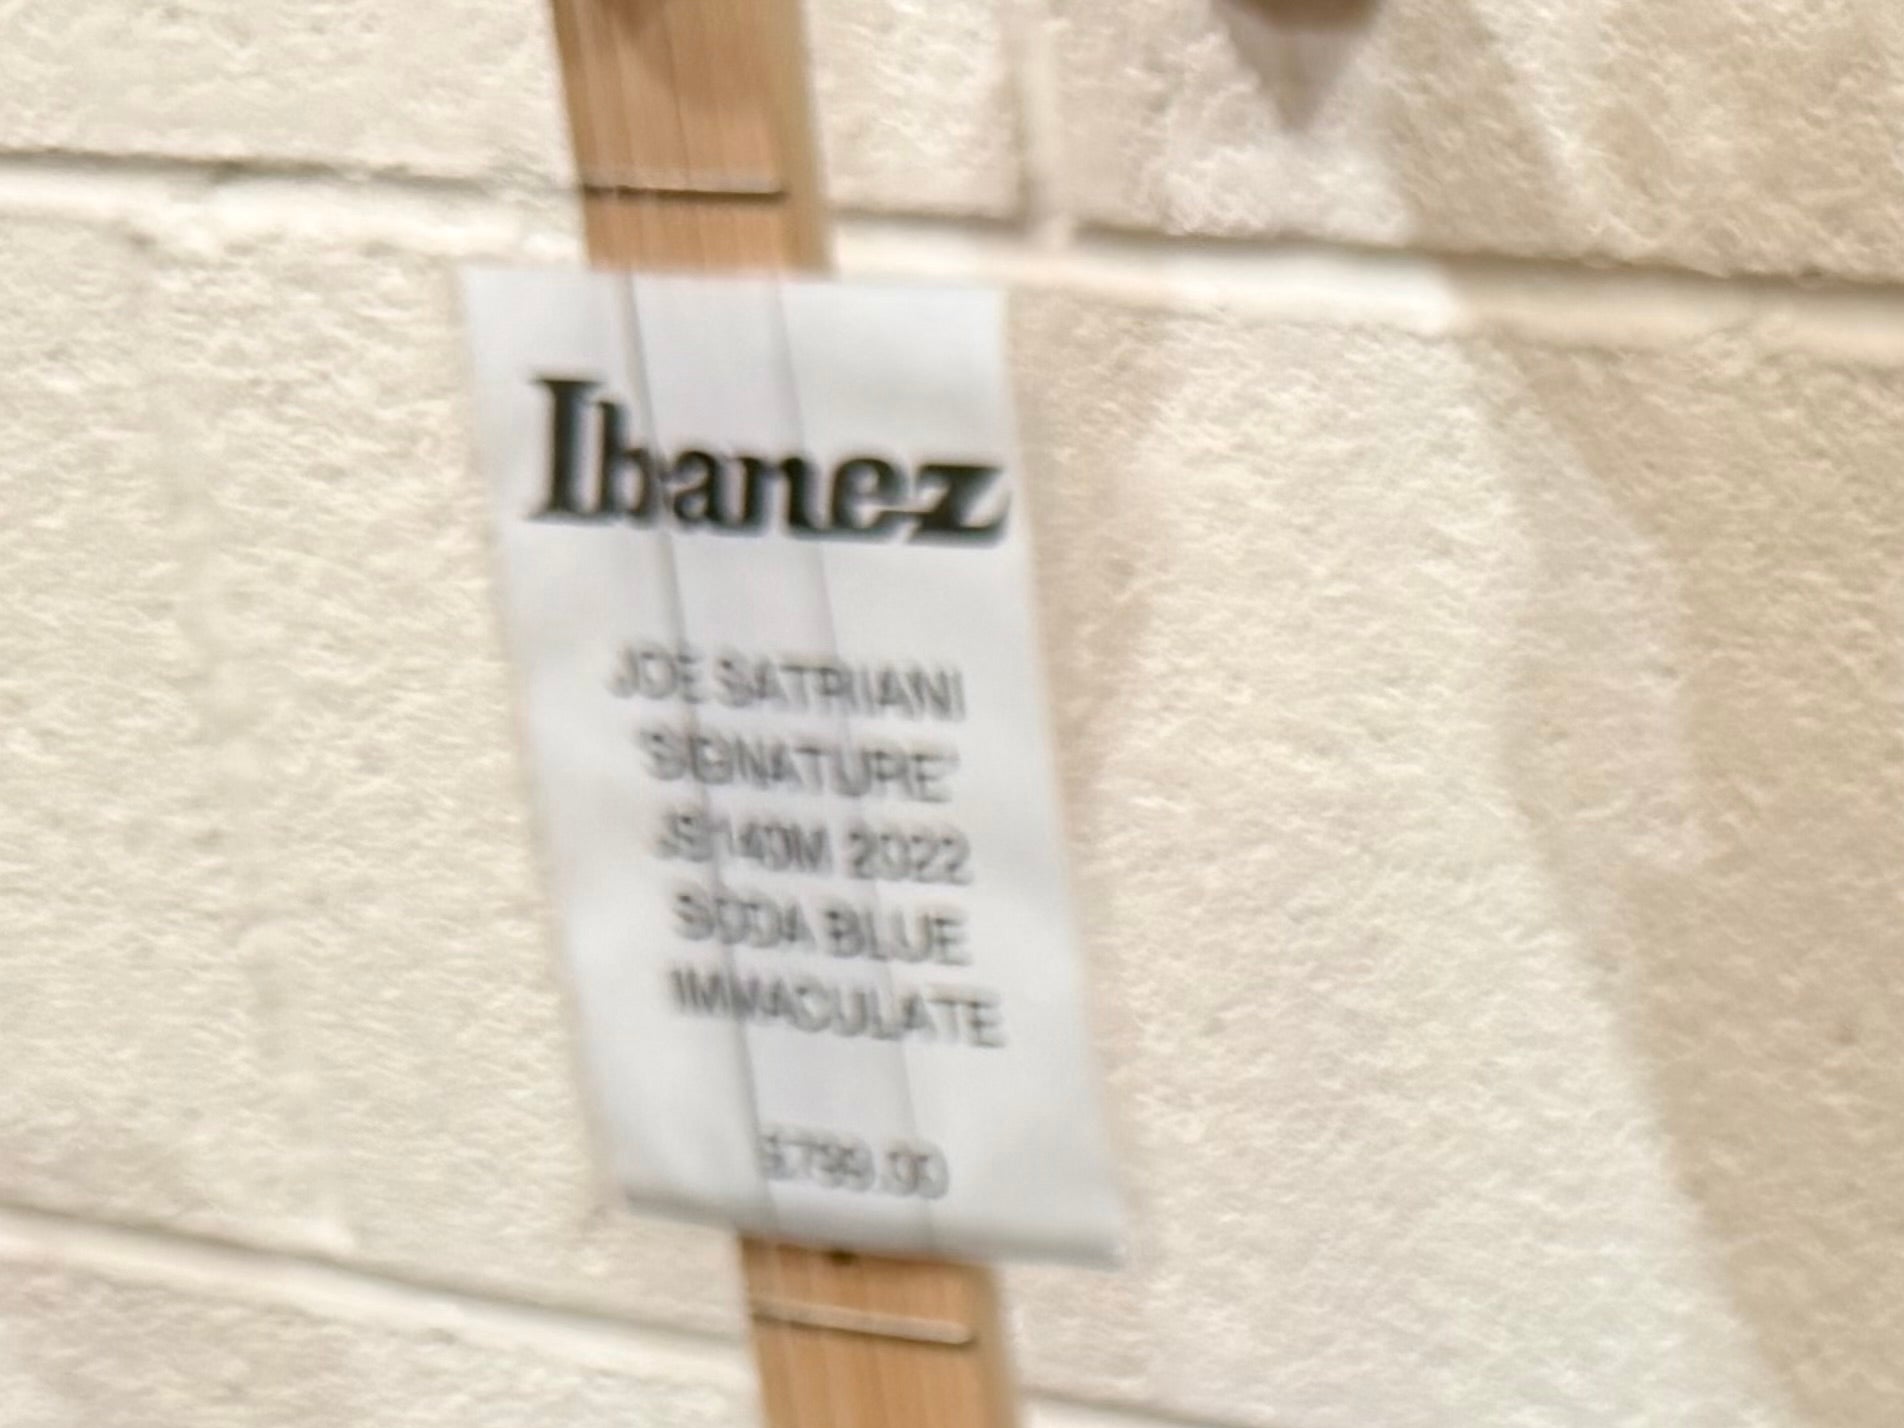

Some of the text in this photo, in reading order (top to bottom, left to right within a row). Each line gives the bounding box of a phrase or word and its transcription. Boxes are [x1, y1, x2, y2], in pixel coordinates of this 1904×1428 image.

[529, 376, 1013, 545] Ibanez
[608, 644, 967, 724] JOE SATRIANI
[636, 722, 960, 804] SIGNATURE
[844, 815, 976, 886] 2022
[671, 878, 972, 967] SODA BLUE
[669, 966, 1008, 1049] IMMACULATE
